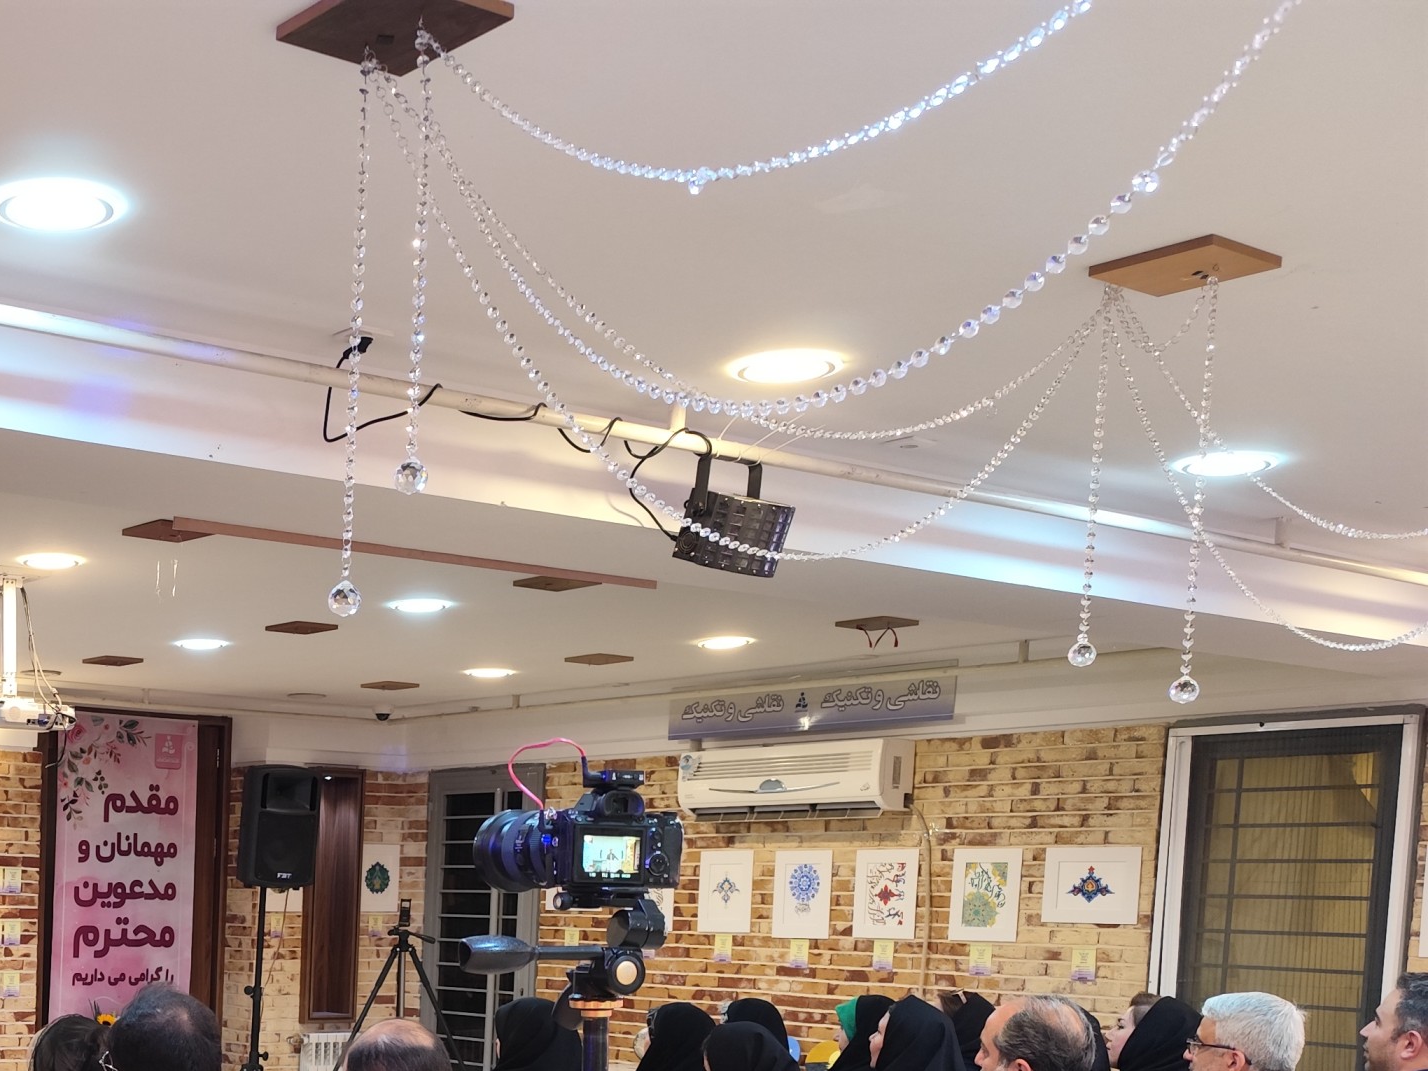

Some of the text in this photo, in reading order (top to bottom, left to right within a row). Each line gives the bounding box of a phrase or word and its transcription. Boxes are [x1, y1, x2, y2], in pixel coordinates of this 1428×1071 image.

[681, 693, 785, 723] نقاشی و تکنیک
[820, 679, 942, 712] نقاشی و تکنیک
[103, 783, 179, 823] مقدم
[77, 832, 178, 867] مهمانان و
[73, 878, 177, 909] مدعوین
[73, 916, 175, 958] محترم
[72, 968, 105, 986] داریم
[108, 972, 126, 986] می
[128, 966, 163, 986] گرامی
